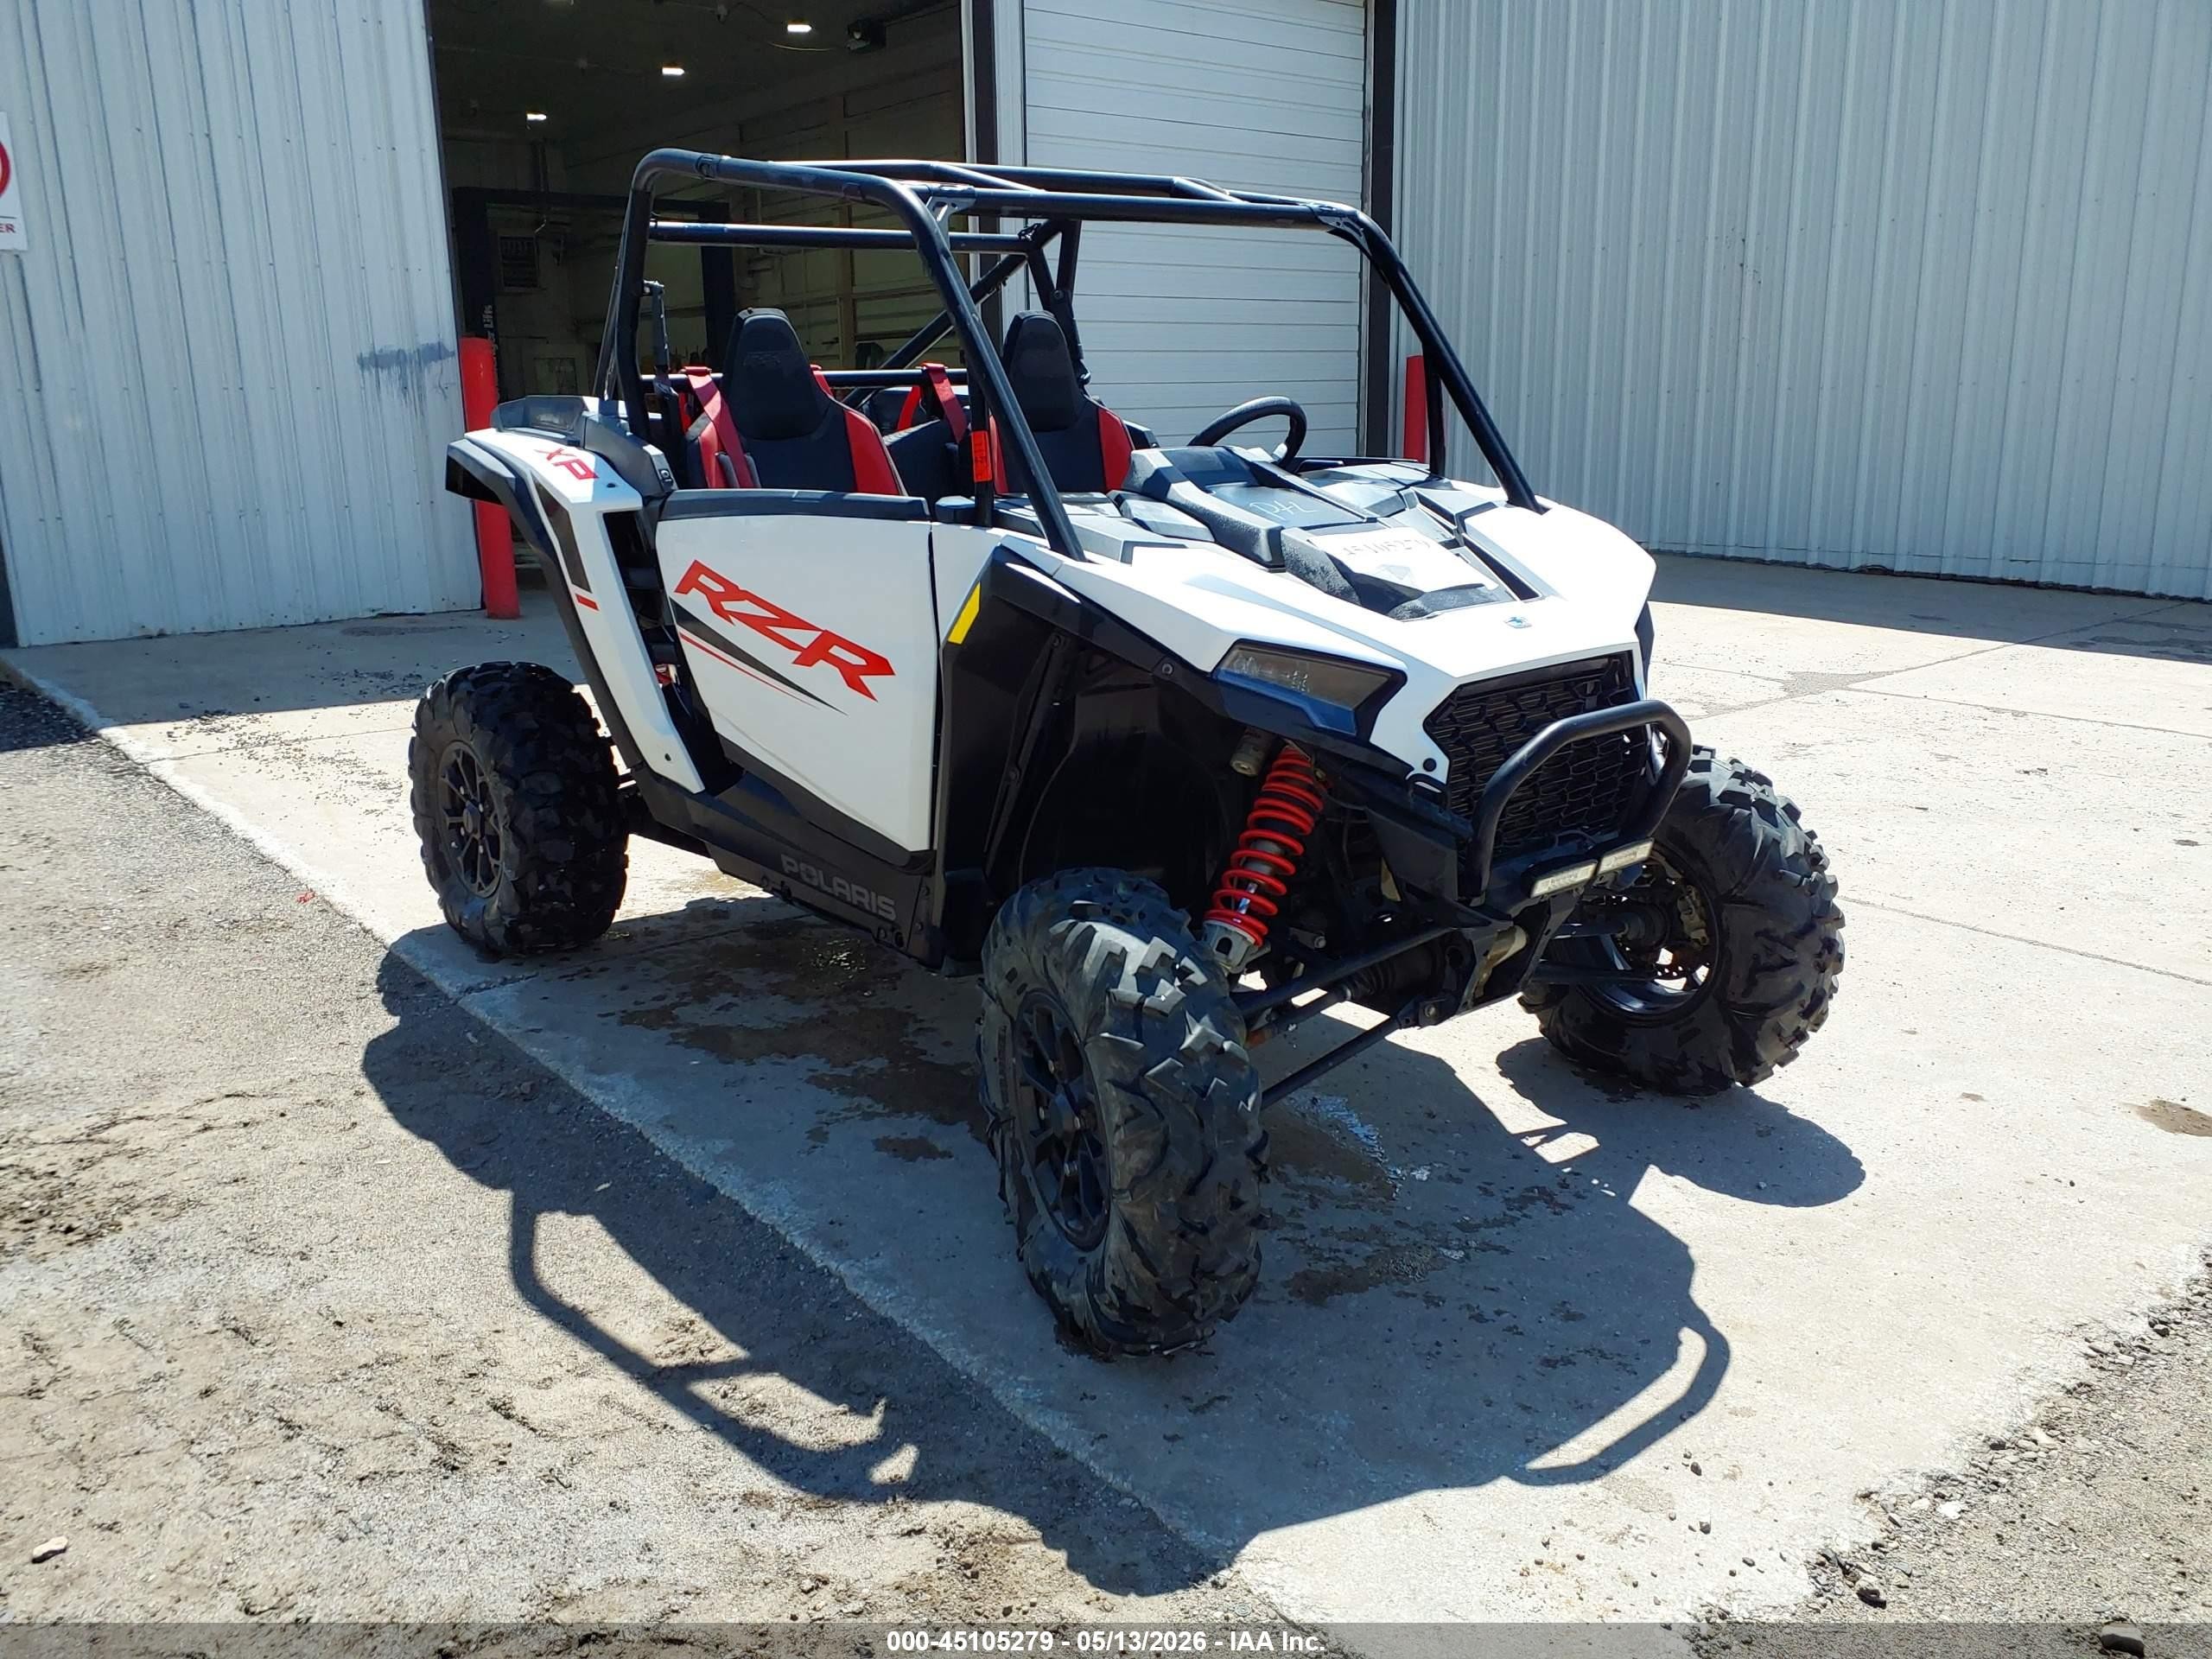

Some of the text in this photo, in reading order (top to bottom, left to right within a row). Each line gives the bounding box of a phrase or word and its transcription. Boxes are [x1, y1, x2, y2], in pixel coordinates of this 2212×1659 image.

[533, 448, 600, 480] XP
[673, 559, 896, 702] RZR
[780, 854, 897, 921] POLARIS
